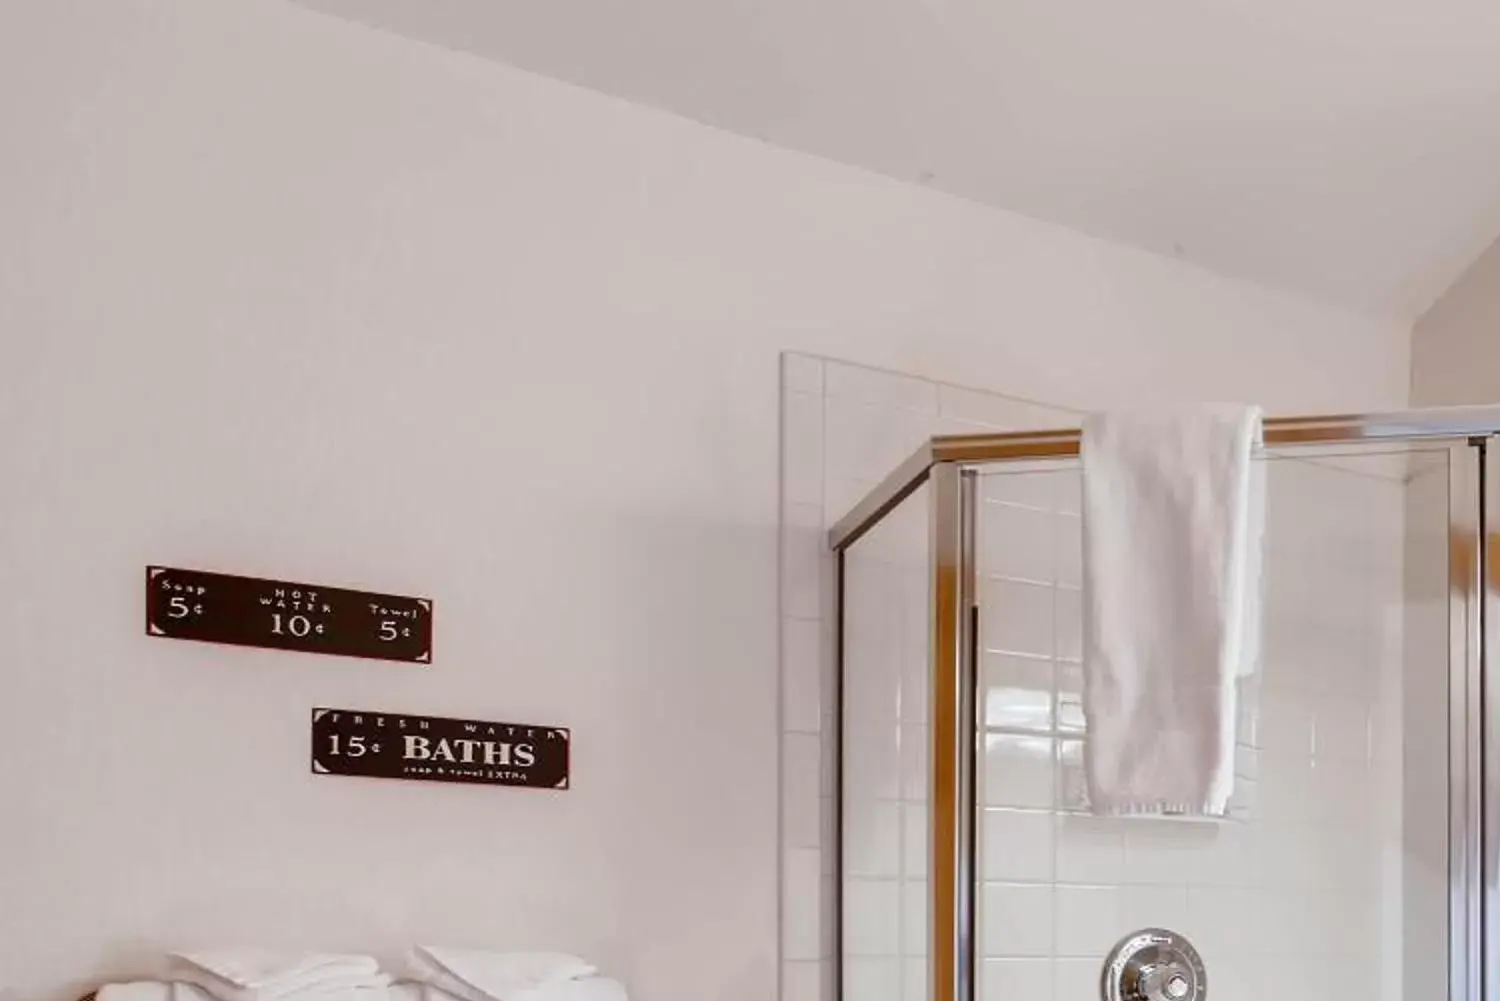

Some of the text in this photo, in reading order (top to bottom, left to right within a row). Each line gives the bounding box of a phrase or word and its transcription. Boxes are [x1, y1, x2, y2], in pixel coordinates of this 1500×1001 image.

[274, 588, 318, 603] HOT
[259, 597, 333, 614] WATER
[369, 603, 419, 619] Towel
[332, 713, 557, 740] FRESH WATER
[402, 735, 536, 767] BATHS
